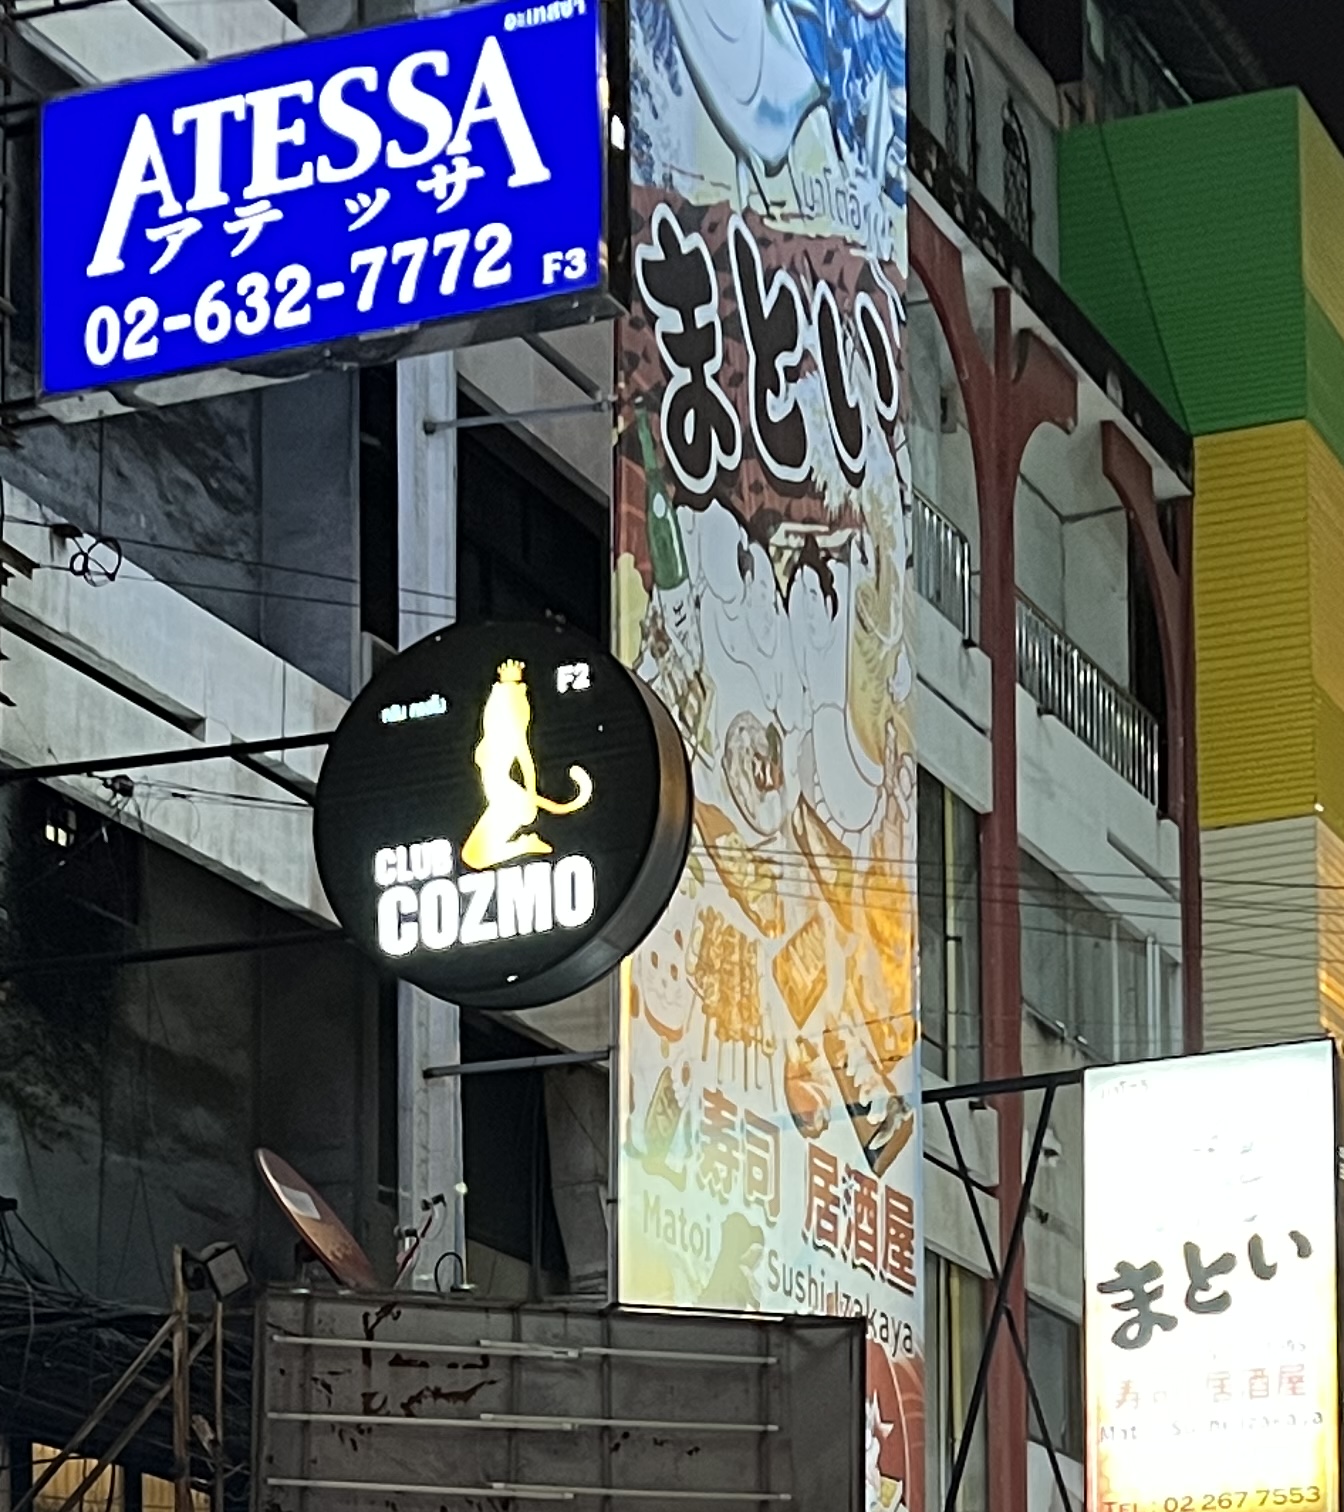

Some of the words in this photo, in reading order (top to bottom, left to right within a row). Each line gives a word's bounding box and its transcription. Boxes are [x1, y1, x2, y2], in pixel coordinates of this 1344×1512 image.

[87, 35, 550, 278] ATESSA
[145, 150, 486, 274] アテッサ
[85, 223, 513, 366] 02-632-7772
[543, 249, 587, 284] F3
[636, 203, 903, 492] まとい
[557, 662, 592, 694] F2
[375, 838, 453, 886] CLUB
[378, 854, 595, 956] COZMO
[698, 1088, 781, 1227] 寿司
[802, 1142, 917, 1297] 居酒屋
[642, 1190, 712, 1262] Matoi
[768, 1249, 826, 1315] Sushi
[835, 1280, 914, 1357] Izakaya
[1096, 1230, 1313, 1350] まとい
[1201, 1490, 1249, 1512] 267
[1256, 1485, 1321, 1508] 7553
